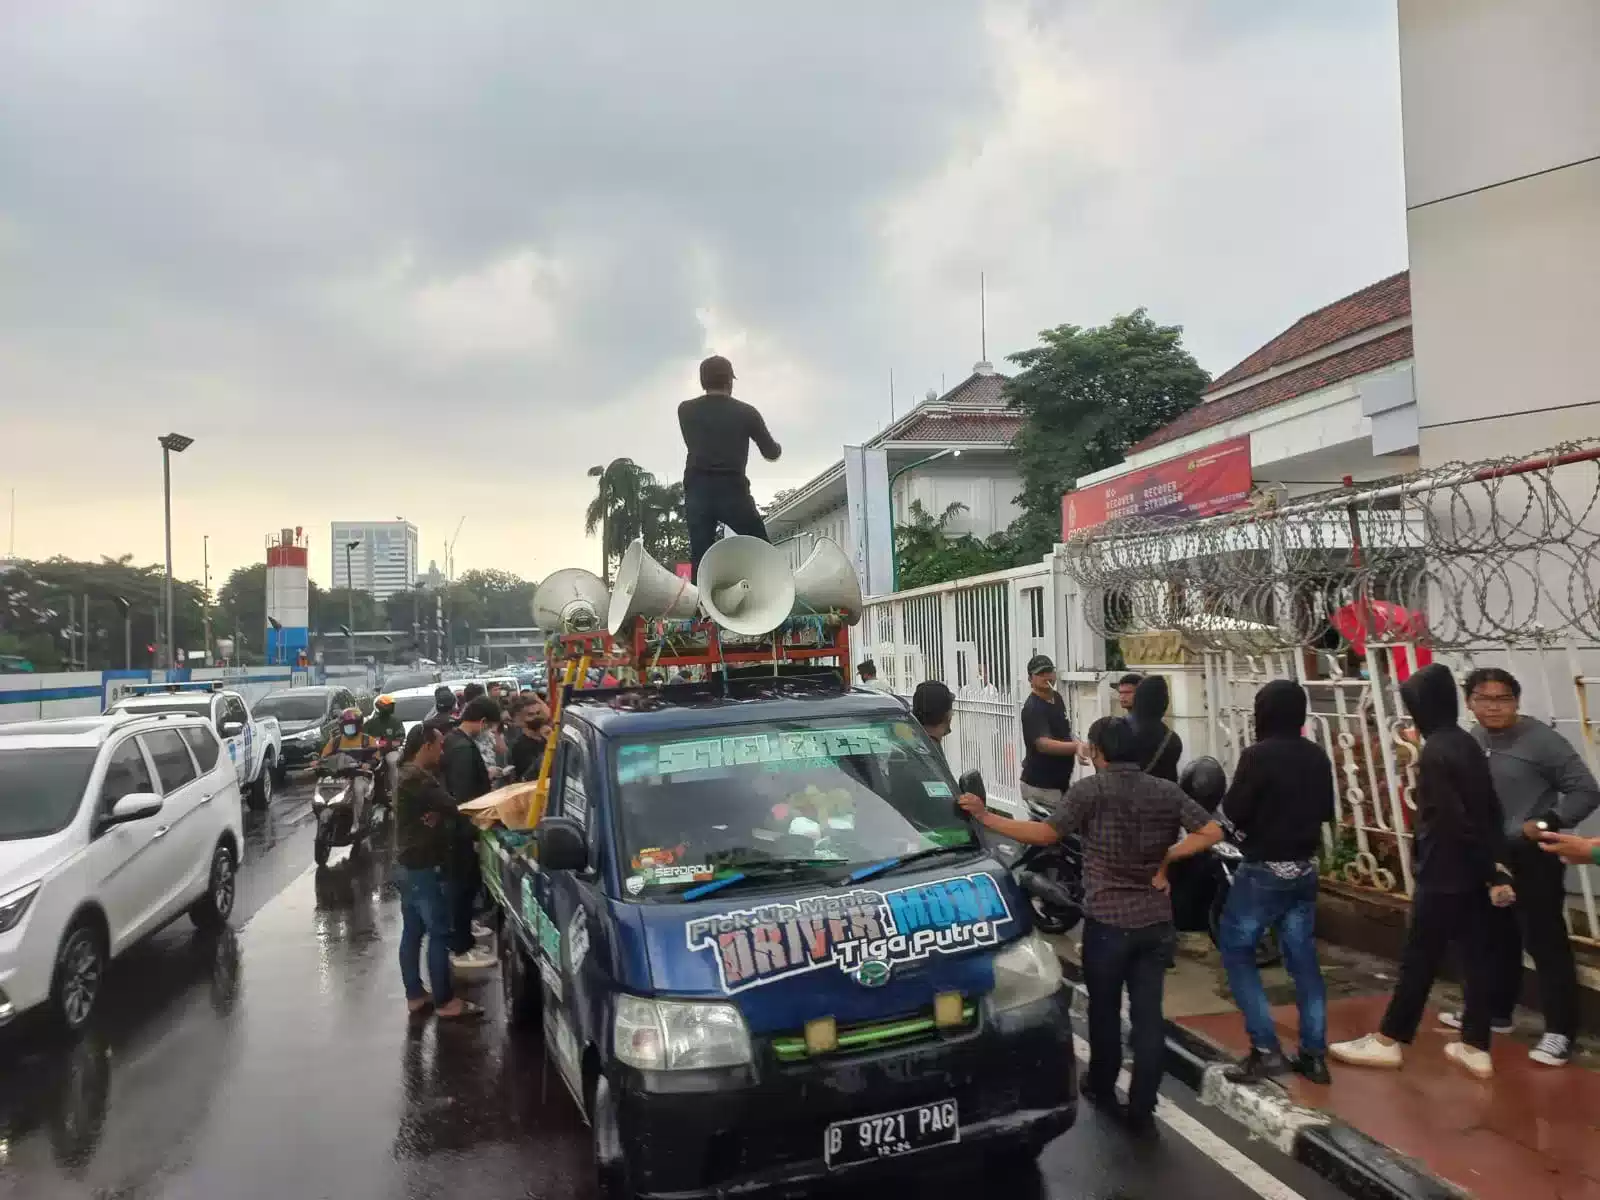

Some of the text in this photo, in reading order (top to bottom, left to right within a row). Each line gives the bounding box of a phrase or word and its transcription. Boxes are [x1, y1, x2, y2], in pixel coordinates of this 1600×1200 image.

[718, 905, 881, 983] DRIVER
[837, 922, 989, 963] Tiga Putra
[830, 1103, 956, 1154] B 9721 PAG
